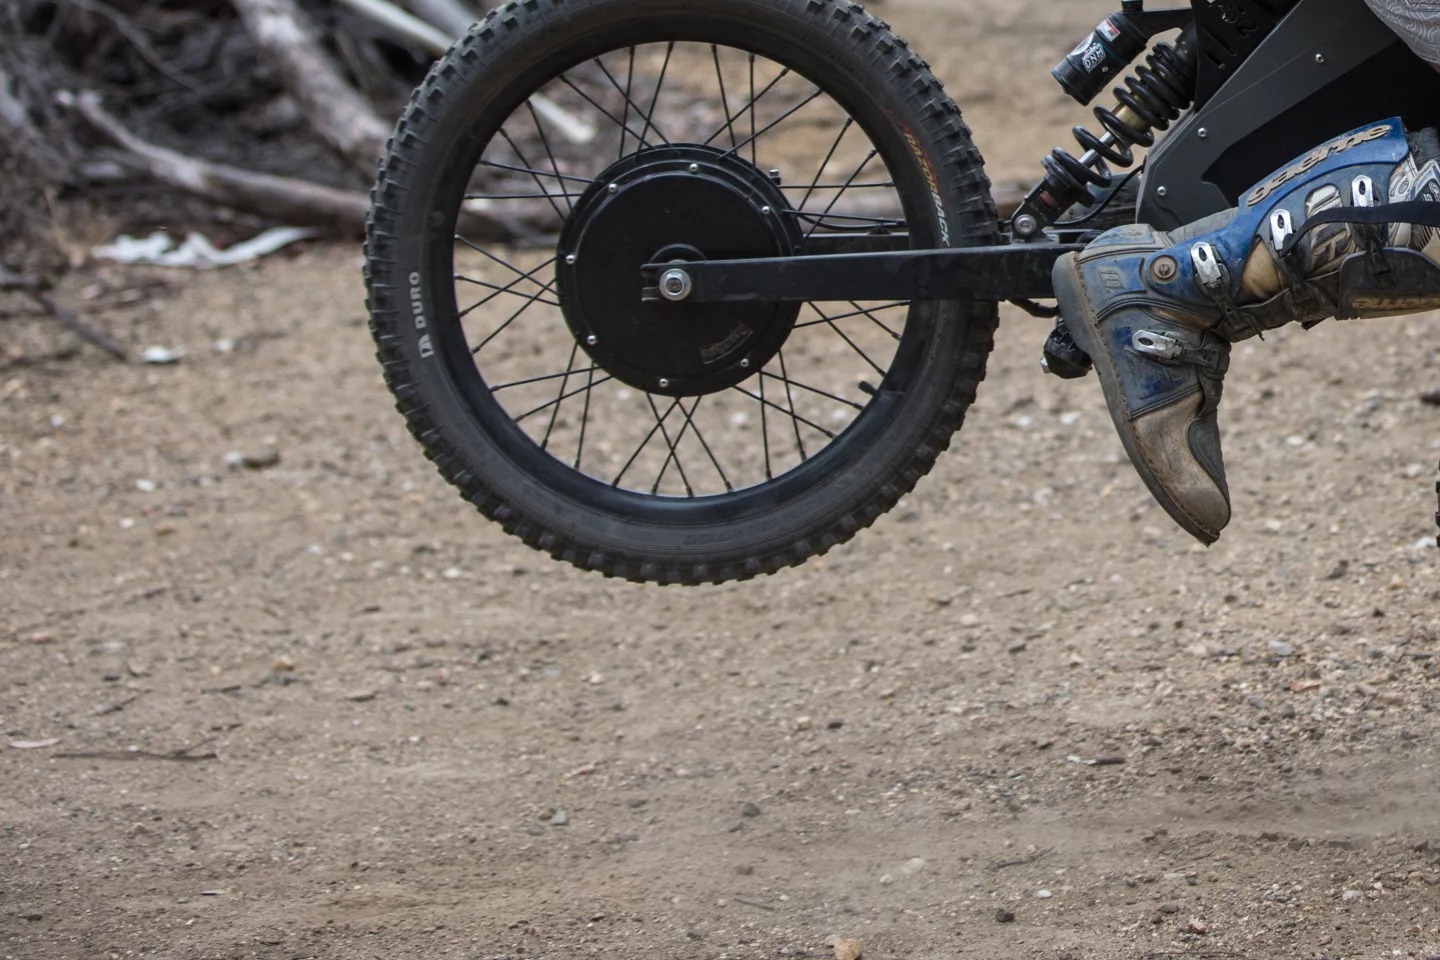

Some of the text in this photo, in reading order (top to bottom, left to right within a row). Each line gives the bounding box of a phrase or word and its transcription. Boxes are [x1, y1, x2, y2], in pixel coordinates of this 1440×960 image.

[1085, 46, 1105, 69] DNM
[903, 132, 951, 248] RAZORBACK
[1246, 124, 1393, 207] gaerne
[408, 271, 427, 330] DURO
